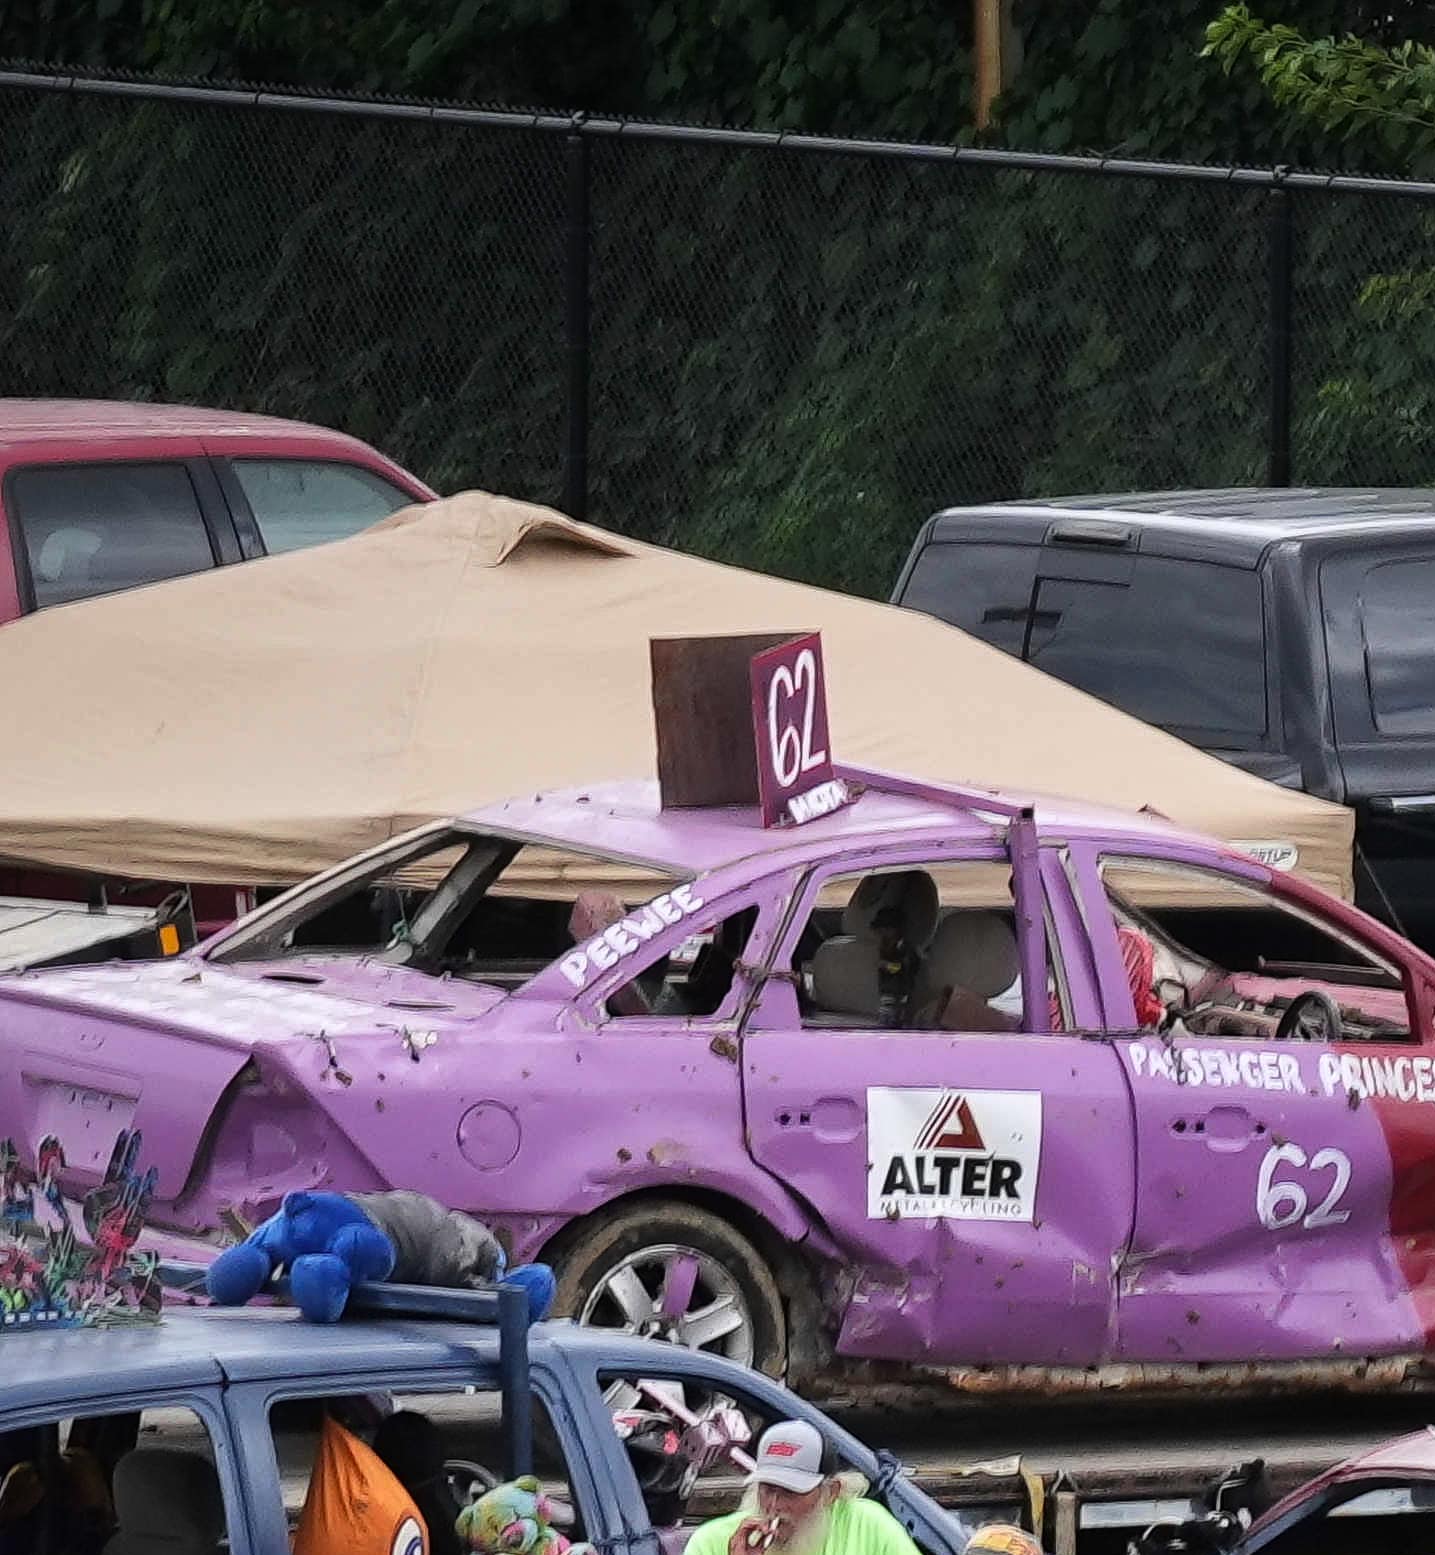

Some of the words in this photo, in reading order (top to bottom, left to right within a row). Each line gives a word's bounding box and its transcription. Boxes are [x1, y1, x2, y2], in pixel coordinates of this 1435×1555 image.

[769, 649, 826, 788] 62
[560, 883, 705, 987] PEEWEE
[881, 1154, 1022, 1199] ALTER
[1256, 1142, 1352, 1231] 62
